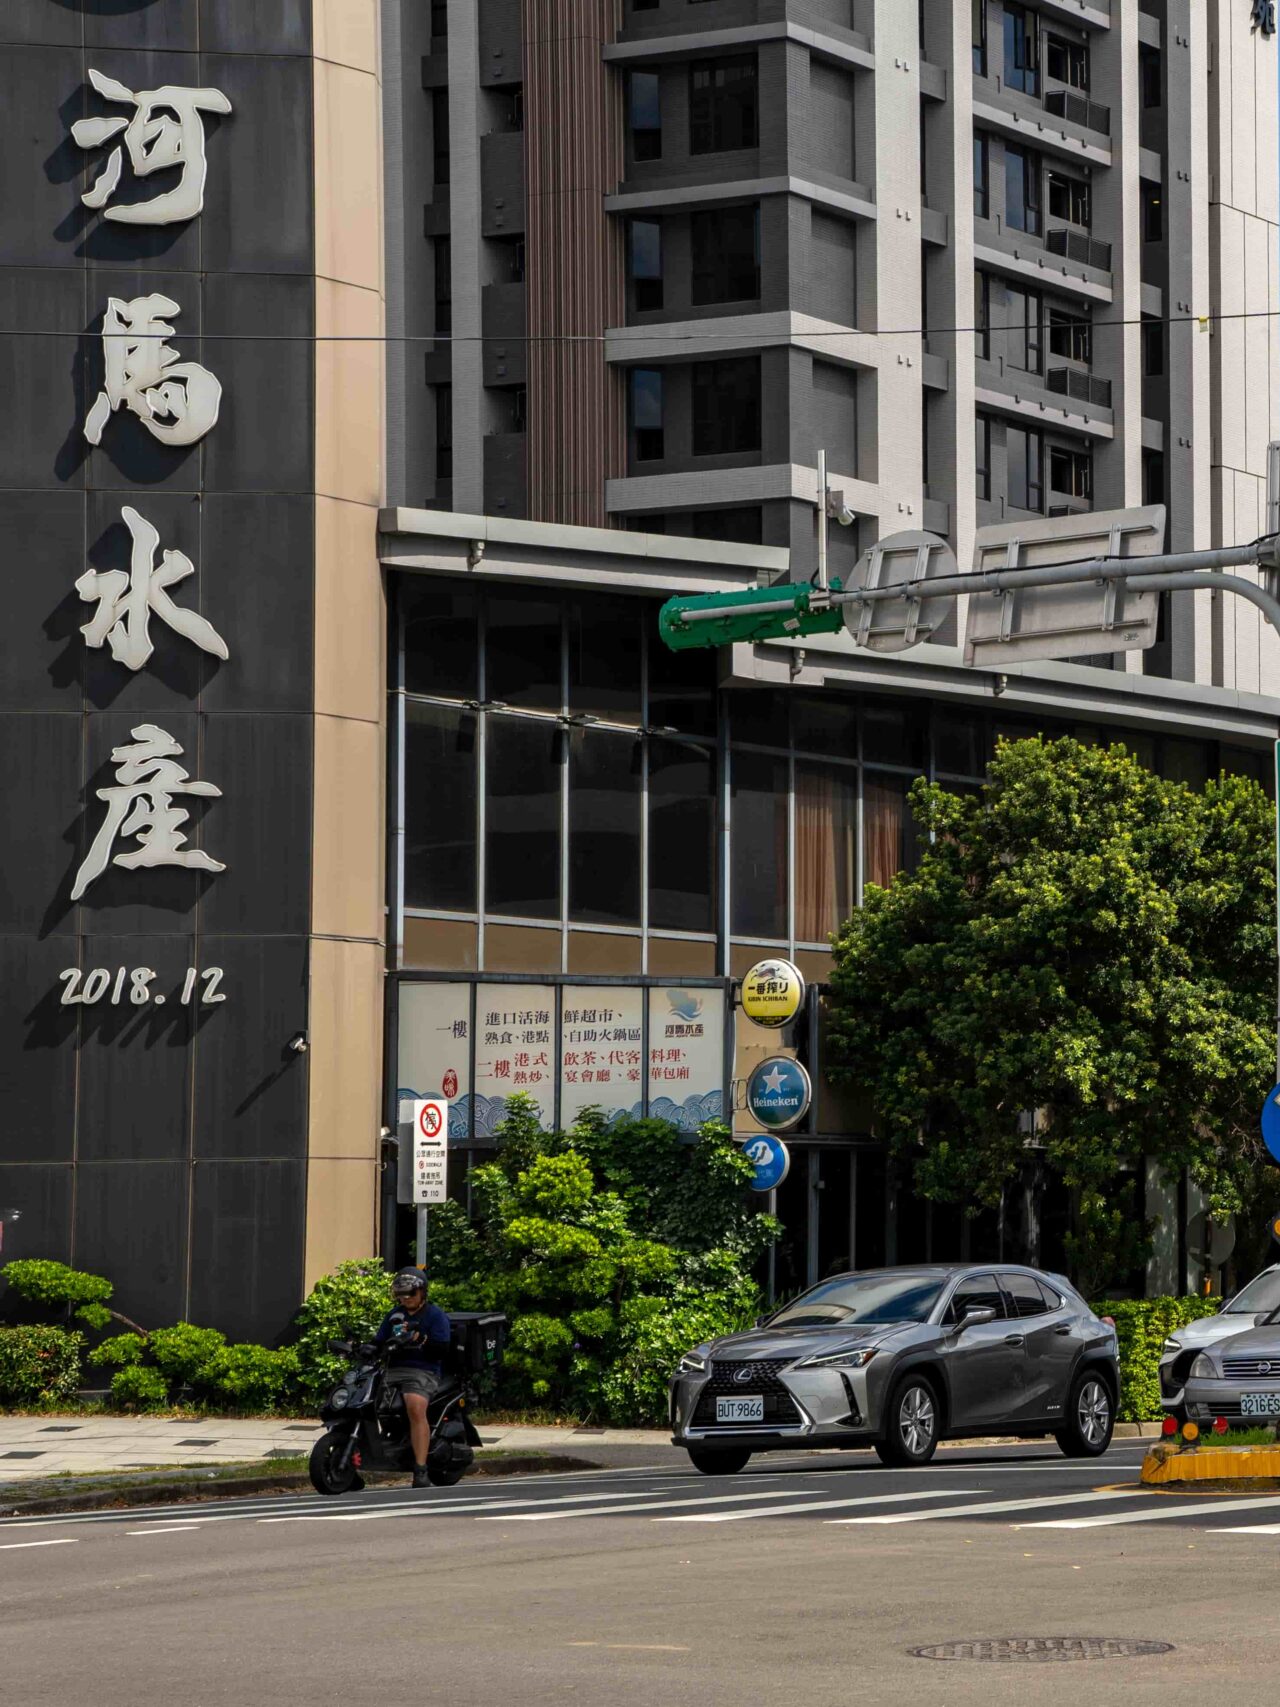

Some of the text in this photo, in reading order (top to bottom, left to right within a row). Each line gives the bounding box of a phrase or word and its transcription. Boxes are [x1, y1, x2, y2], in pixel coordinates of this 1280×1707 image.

[59, 966, 227, 1005] 2018.12
[436, 1020, 468, 1039] 一樓
[477, 1060, 511, 1079] 二樓
[754, 1097, 798, 1107] Heineken
